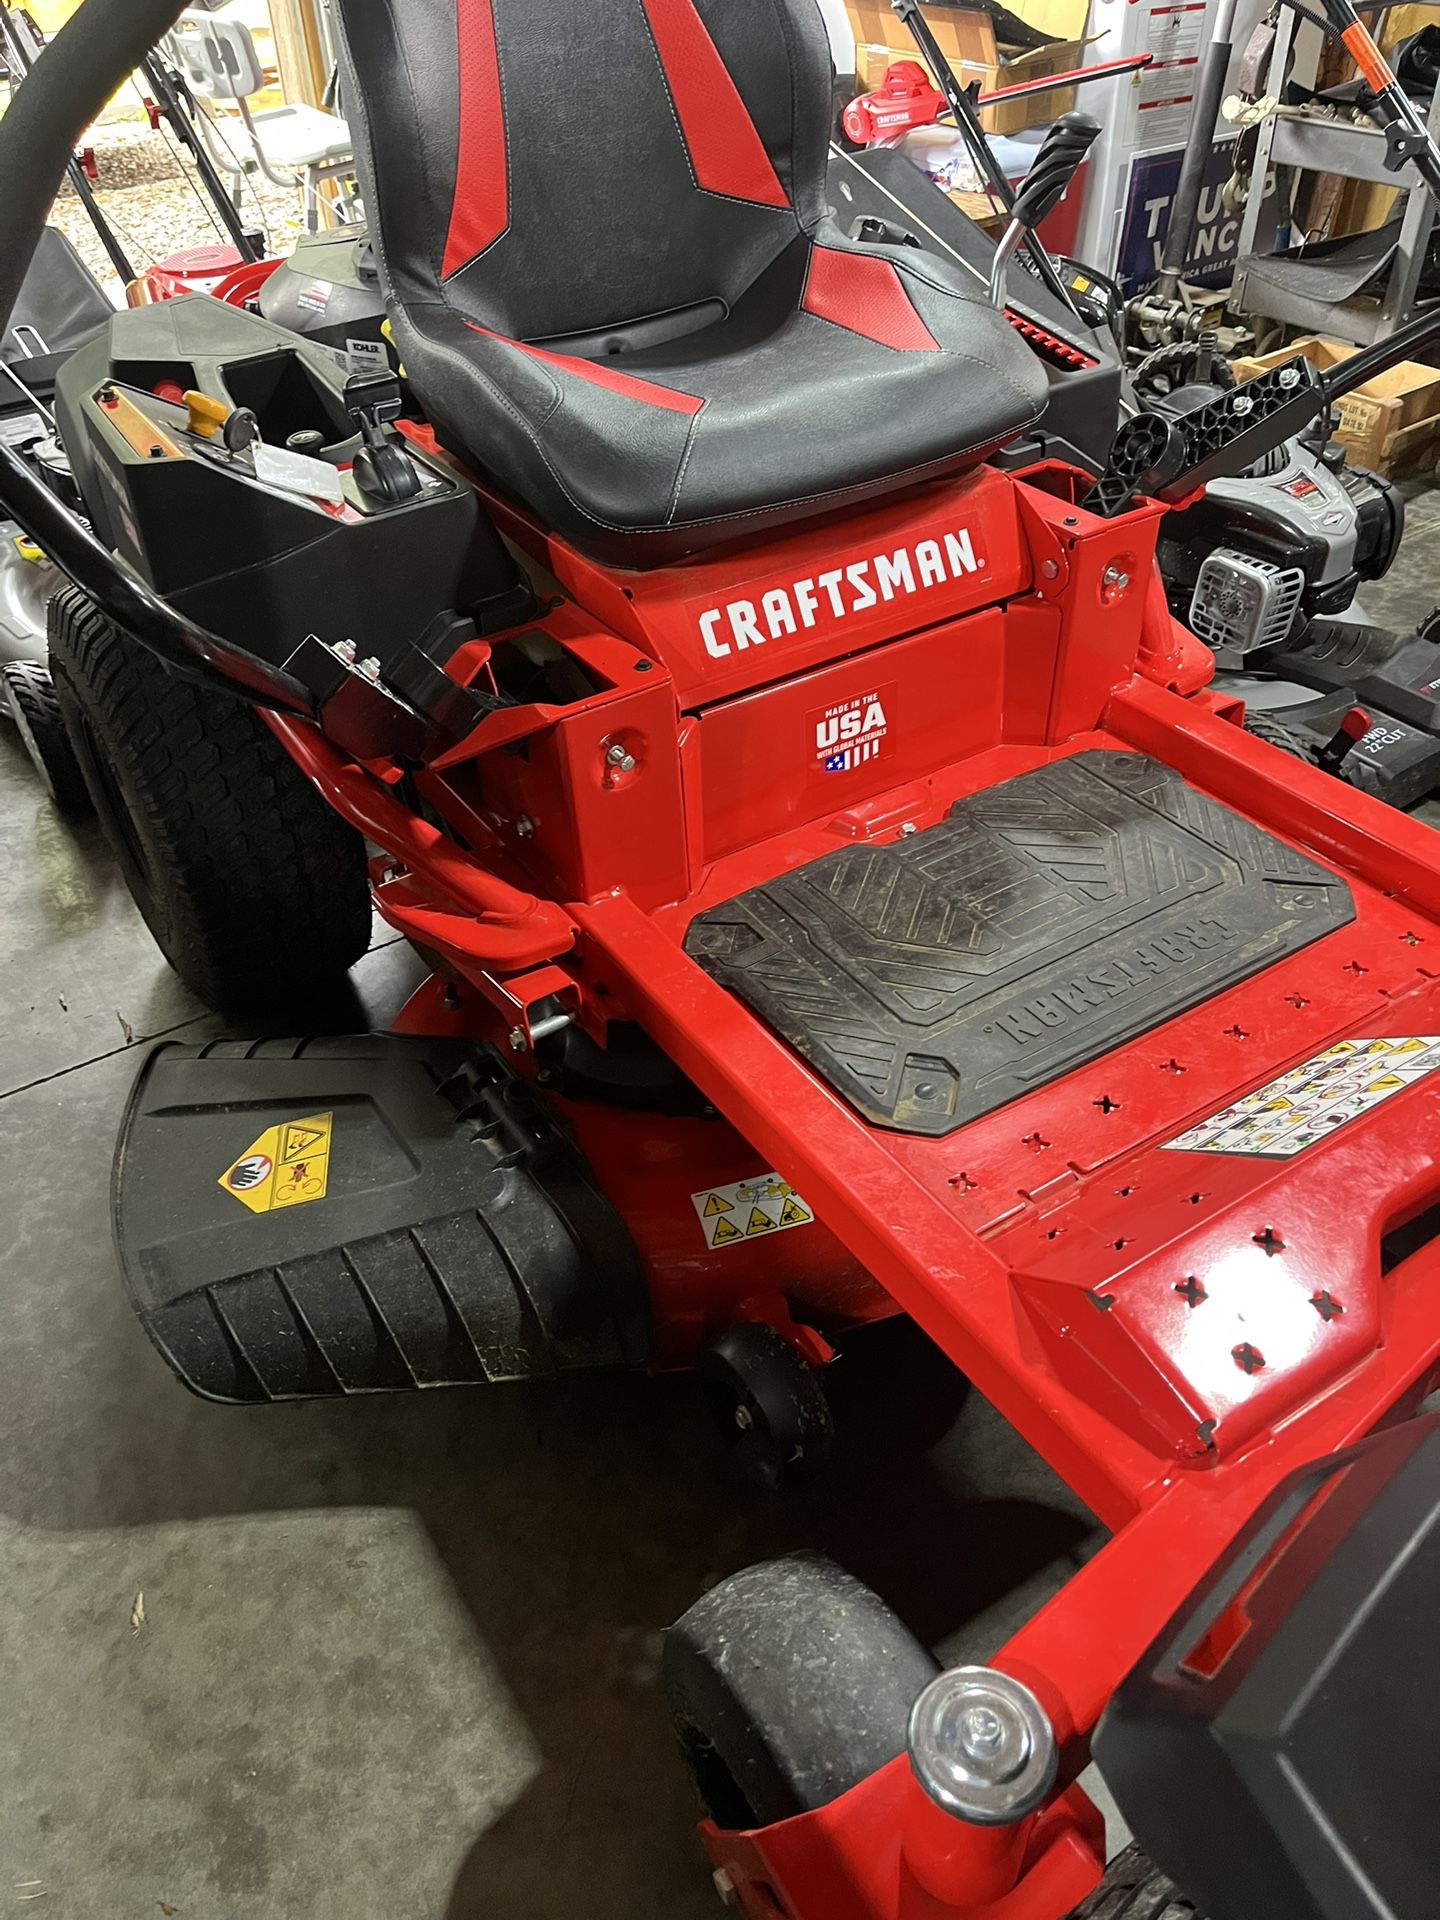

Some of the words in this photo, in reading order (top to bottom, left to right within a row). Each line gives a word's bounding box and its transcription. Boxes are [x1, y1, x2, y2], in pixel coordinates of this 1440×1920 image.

[1144, 171, 1277, 239] TUP
[352, 343, 379, 353] KOHLER
[698, 527, 978, 659] CRAFTSMAN
[825, 703, 849, 718] MADE
[851, 699, 860, 710] IN
[862, 692, 878, 705] THE
[816, 702, 887, 748] USA
[816, 747, 833, 760] WITH
[833, 739, 855, 754] GLOBAL
[855, 727, 887, 745] MATERIALS
